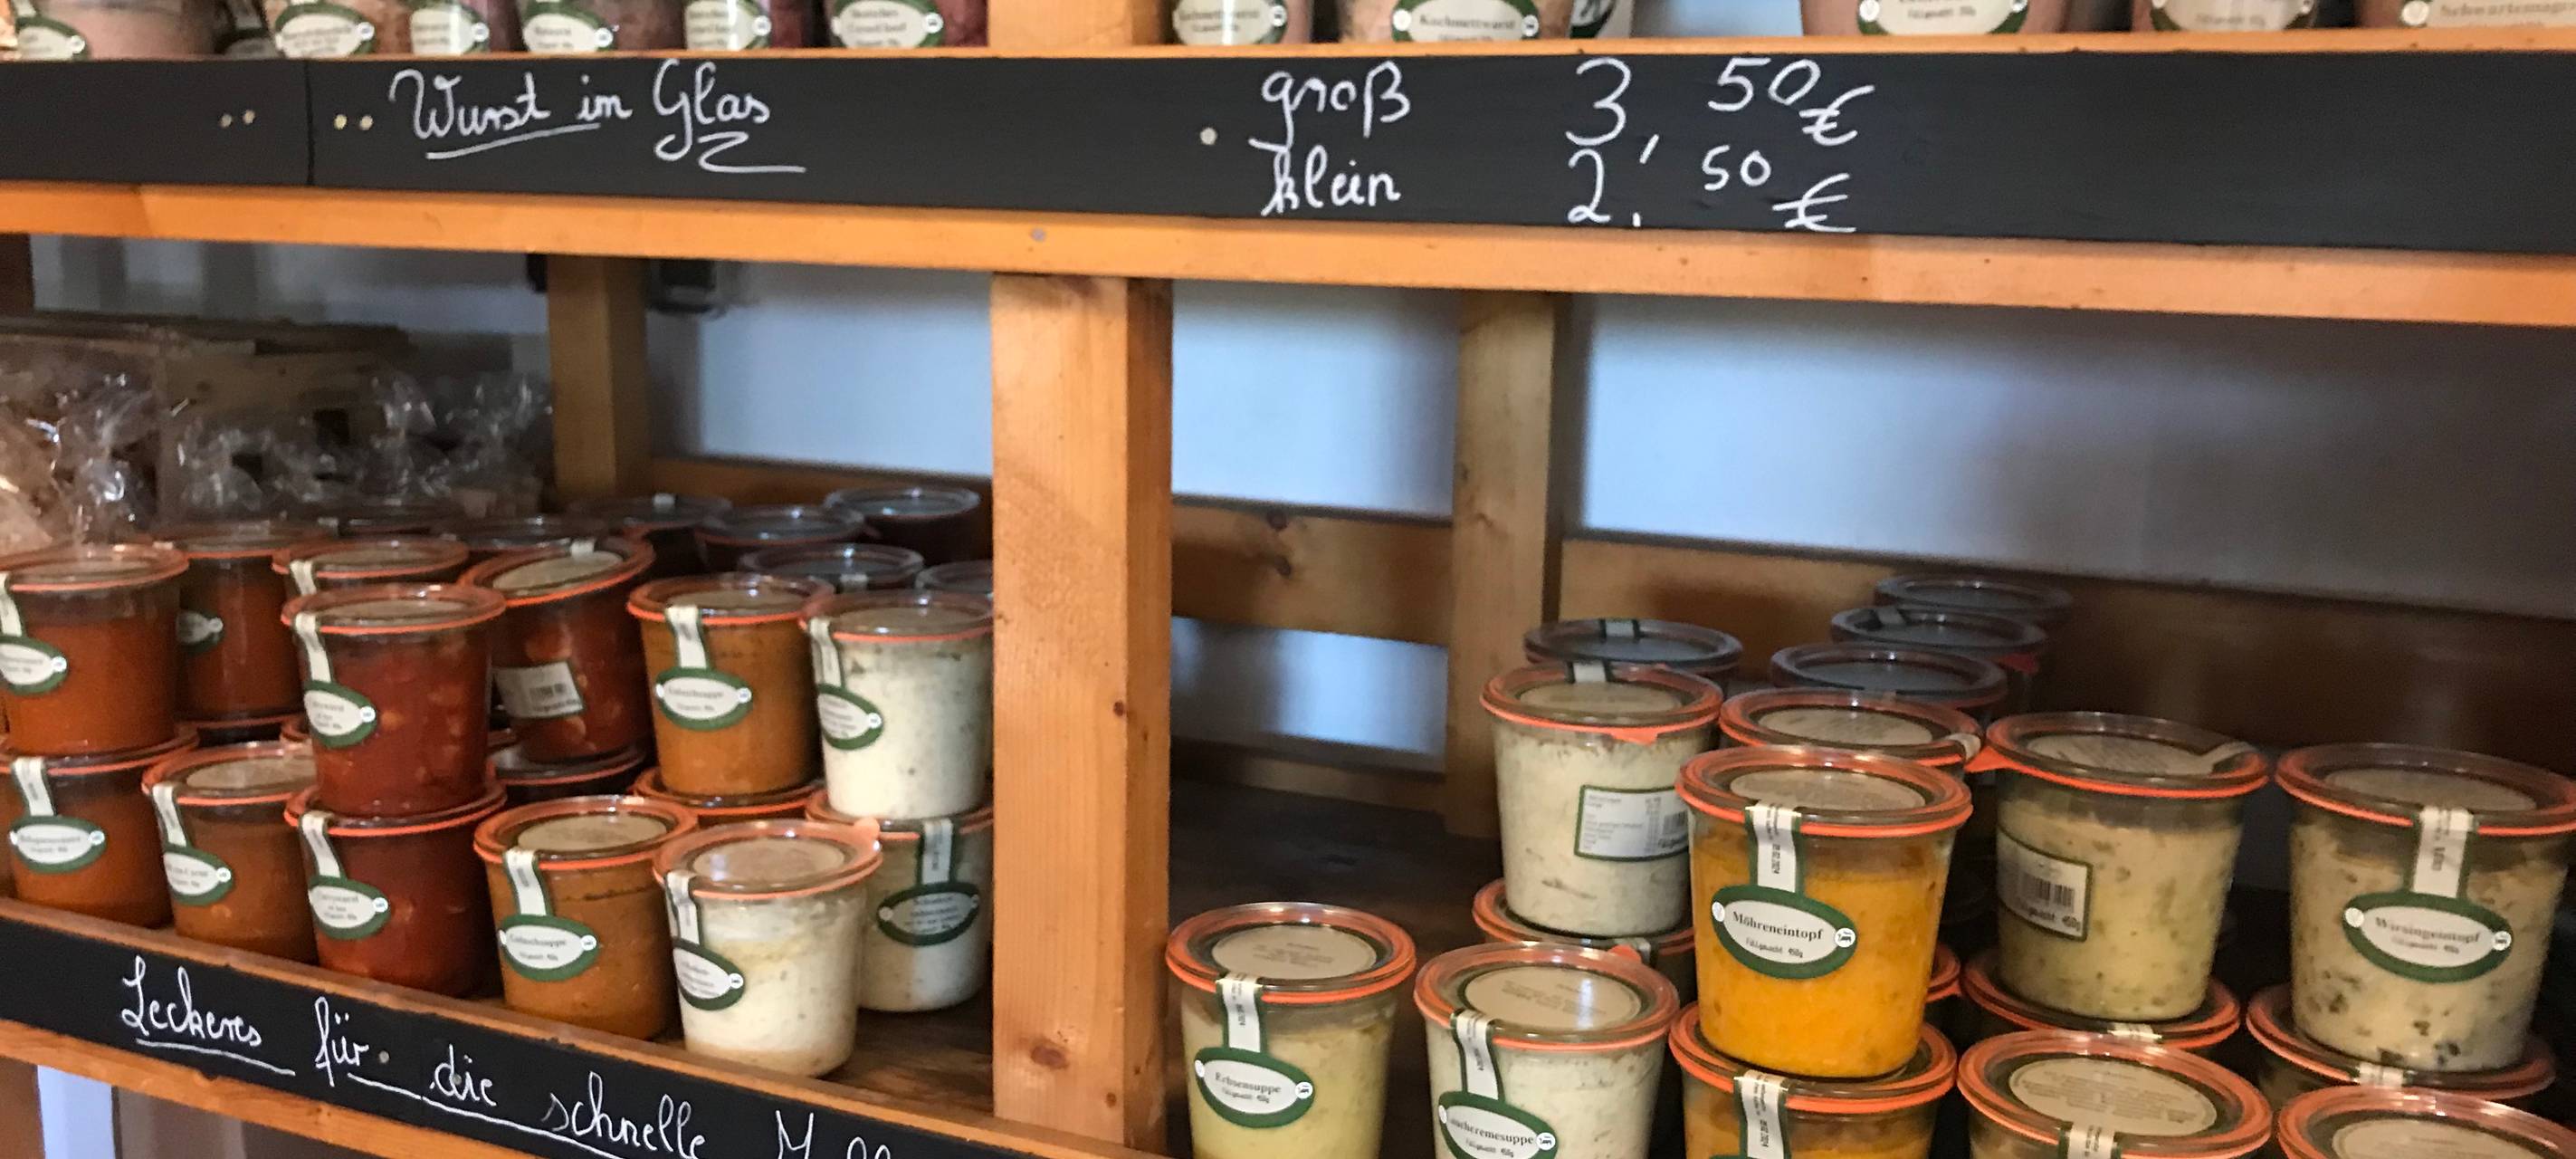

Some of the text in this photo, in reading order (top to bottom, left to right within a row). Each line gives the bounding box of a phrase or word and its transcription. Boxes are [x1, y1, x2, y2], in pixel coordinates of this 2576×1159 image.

[389, 69, 550, 139] Wurst
[653, 59, 770, 161] Glas
[1248, 60, 1411, 152] groß
[1261, 145, 1401, 216] klein
[1732, 911, 1824, 943] Möhreneintopf
[121, 955, 262, 1048] Leckeres
[314, 996, 369, 1087] für
[433, 1043, 497, 1106] die
[541, 1070, 706, 1159] schnelle
[1215, 1071, 1282, 1096] Erbsensuppe
